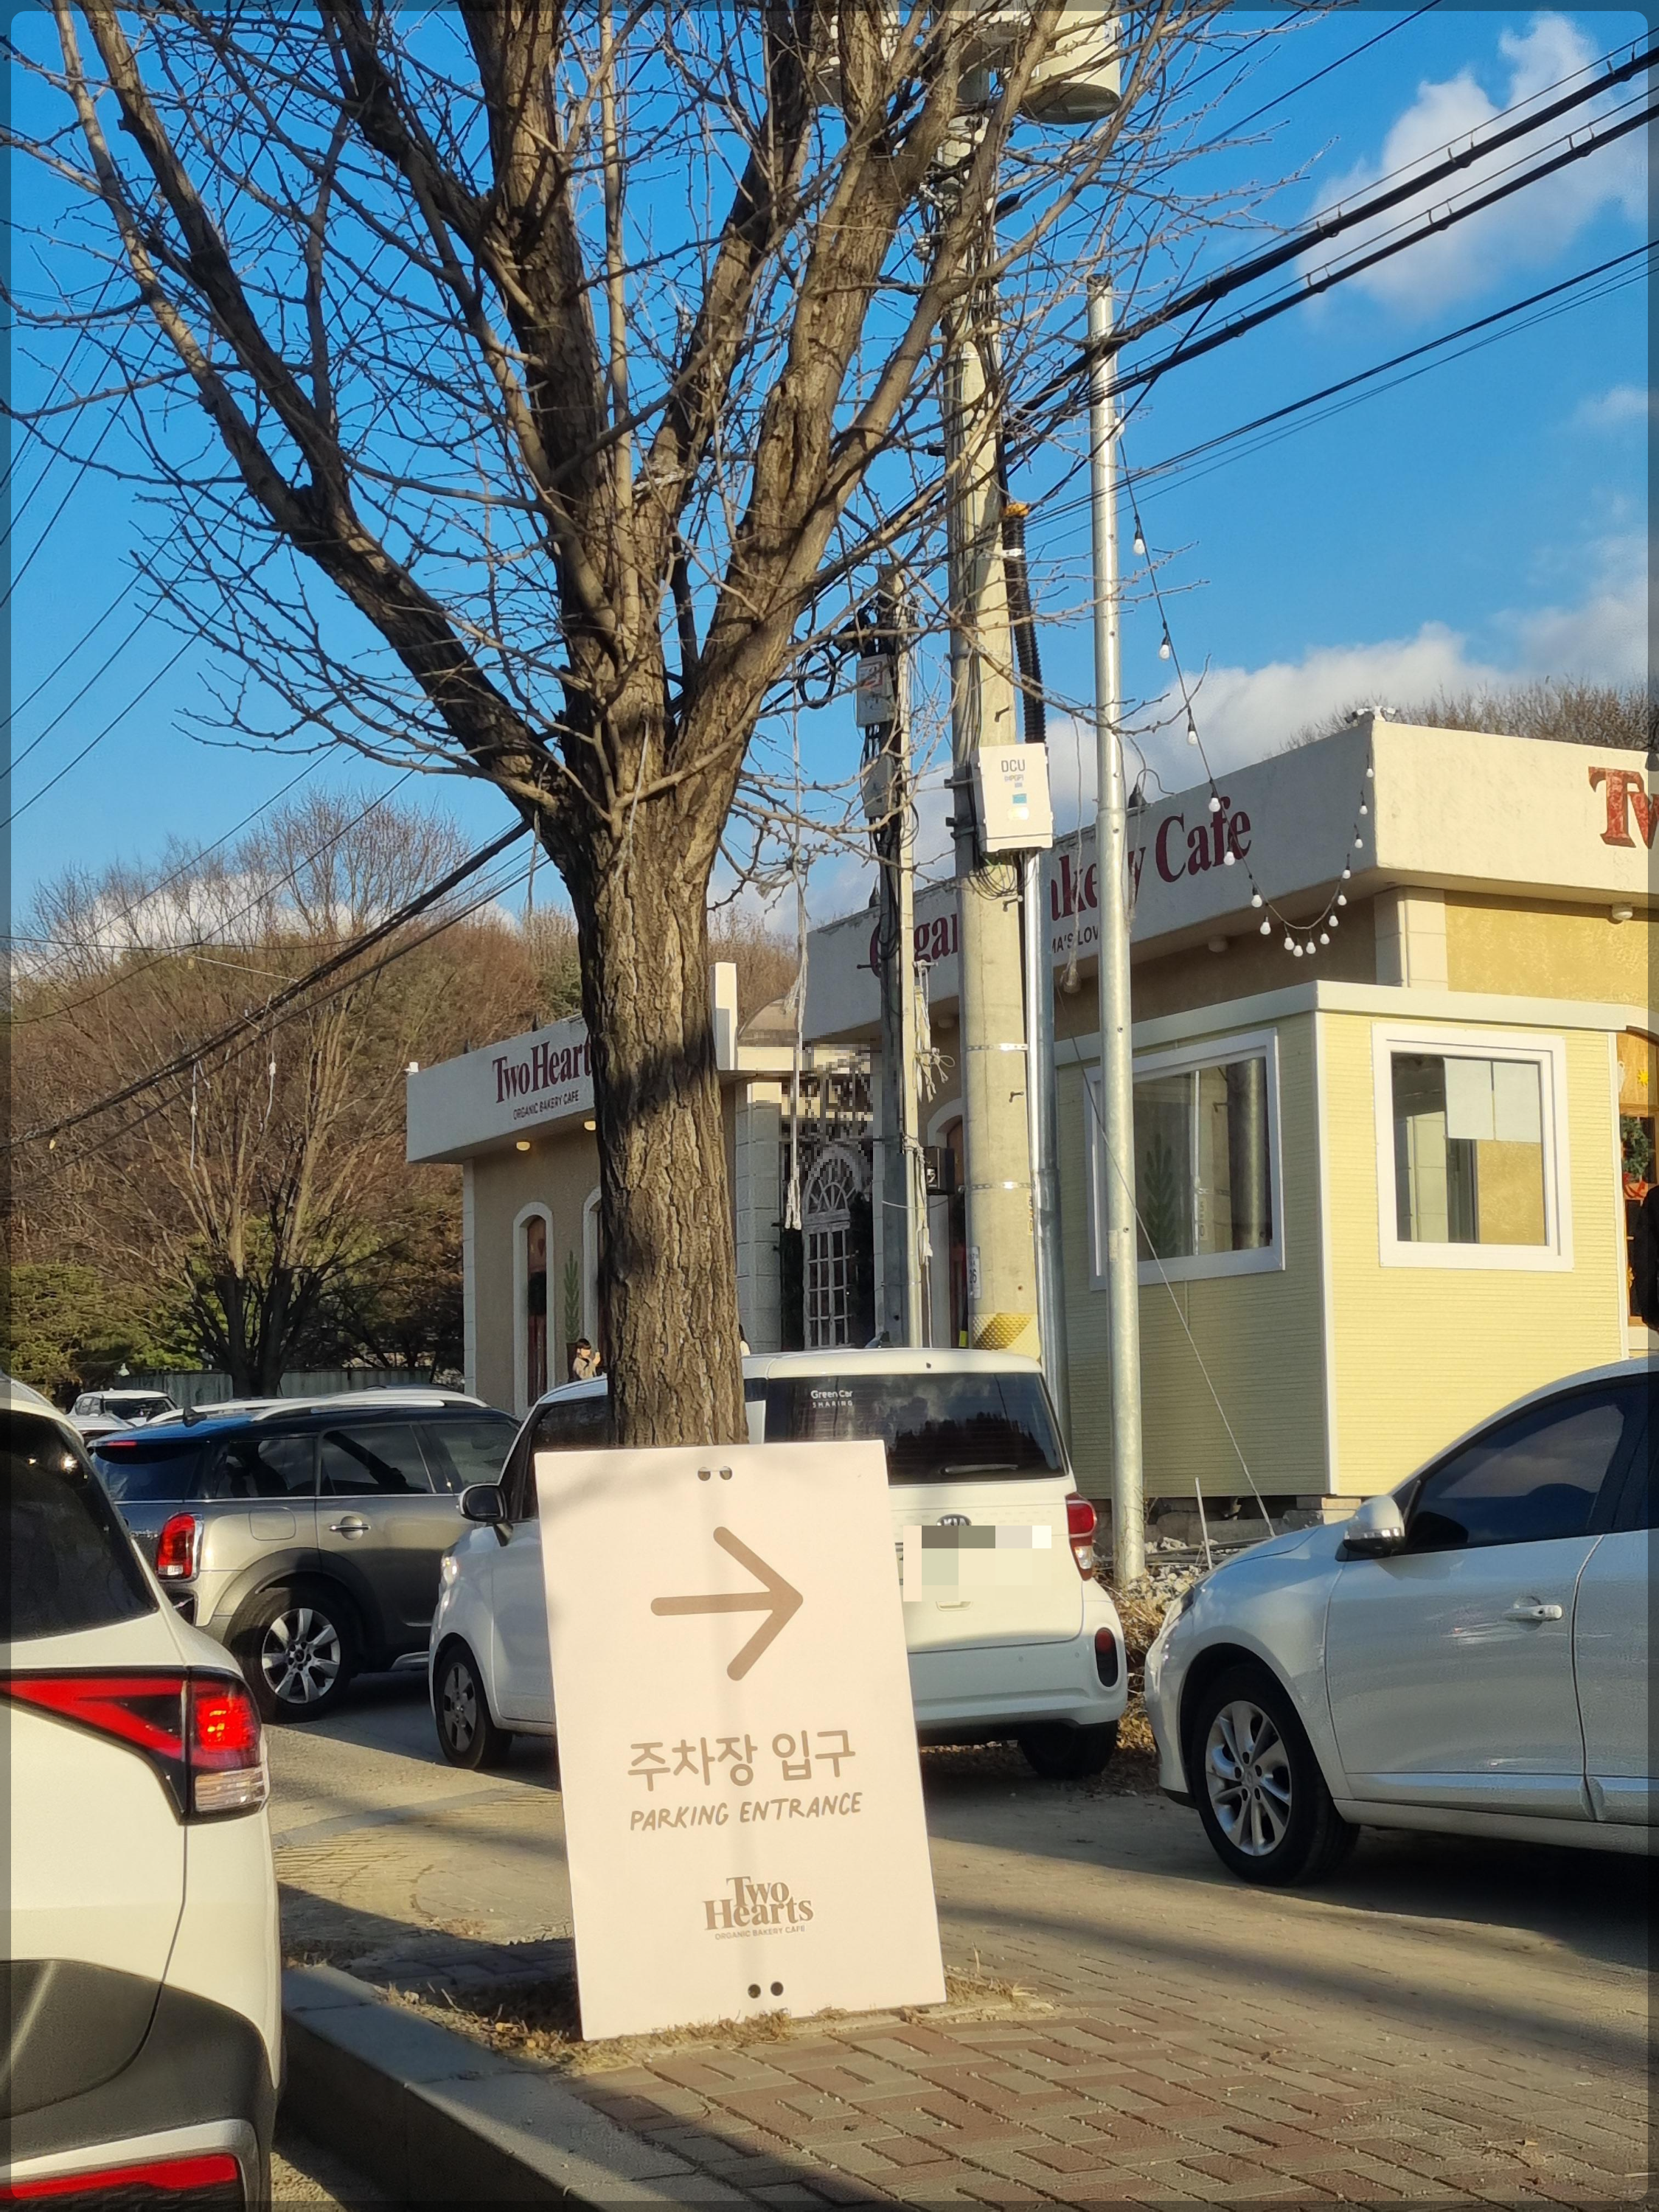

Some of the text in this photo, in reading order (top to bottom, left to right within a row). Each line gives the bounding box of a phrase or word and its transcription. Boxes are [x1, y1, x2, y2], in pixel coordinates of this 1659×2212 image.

[1001, 759, 1026, 772] DCU
[1155, 796, 1252, 883] Cafe
[492, 1056, 530, 1103] Two
[512, 1090, 580, 1120] ORGANIC BAKERY CAFE
[810, 1390, 838, 1399] Green
[813, 1400, 853, 1408] SHARING
[627, 1730, 856, 1792] 주차장 입구
[630, 1792, 863, 1831] PARKING ENTRANCE
[726, 1876, 790, 1907] Two
[702, 1896, 814, 1930] Hearts
[714, 1924, 806, 1941] ORGANIC BAKERY CAFE
